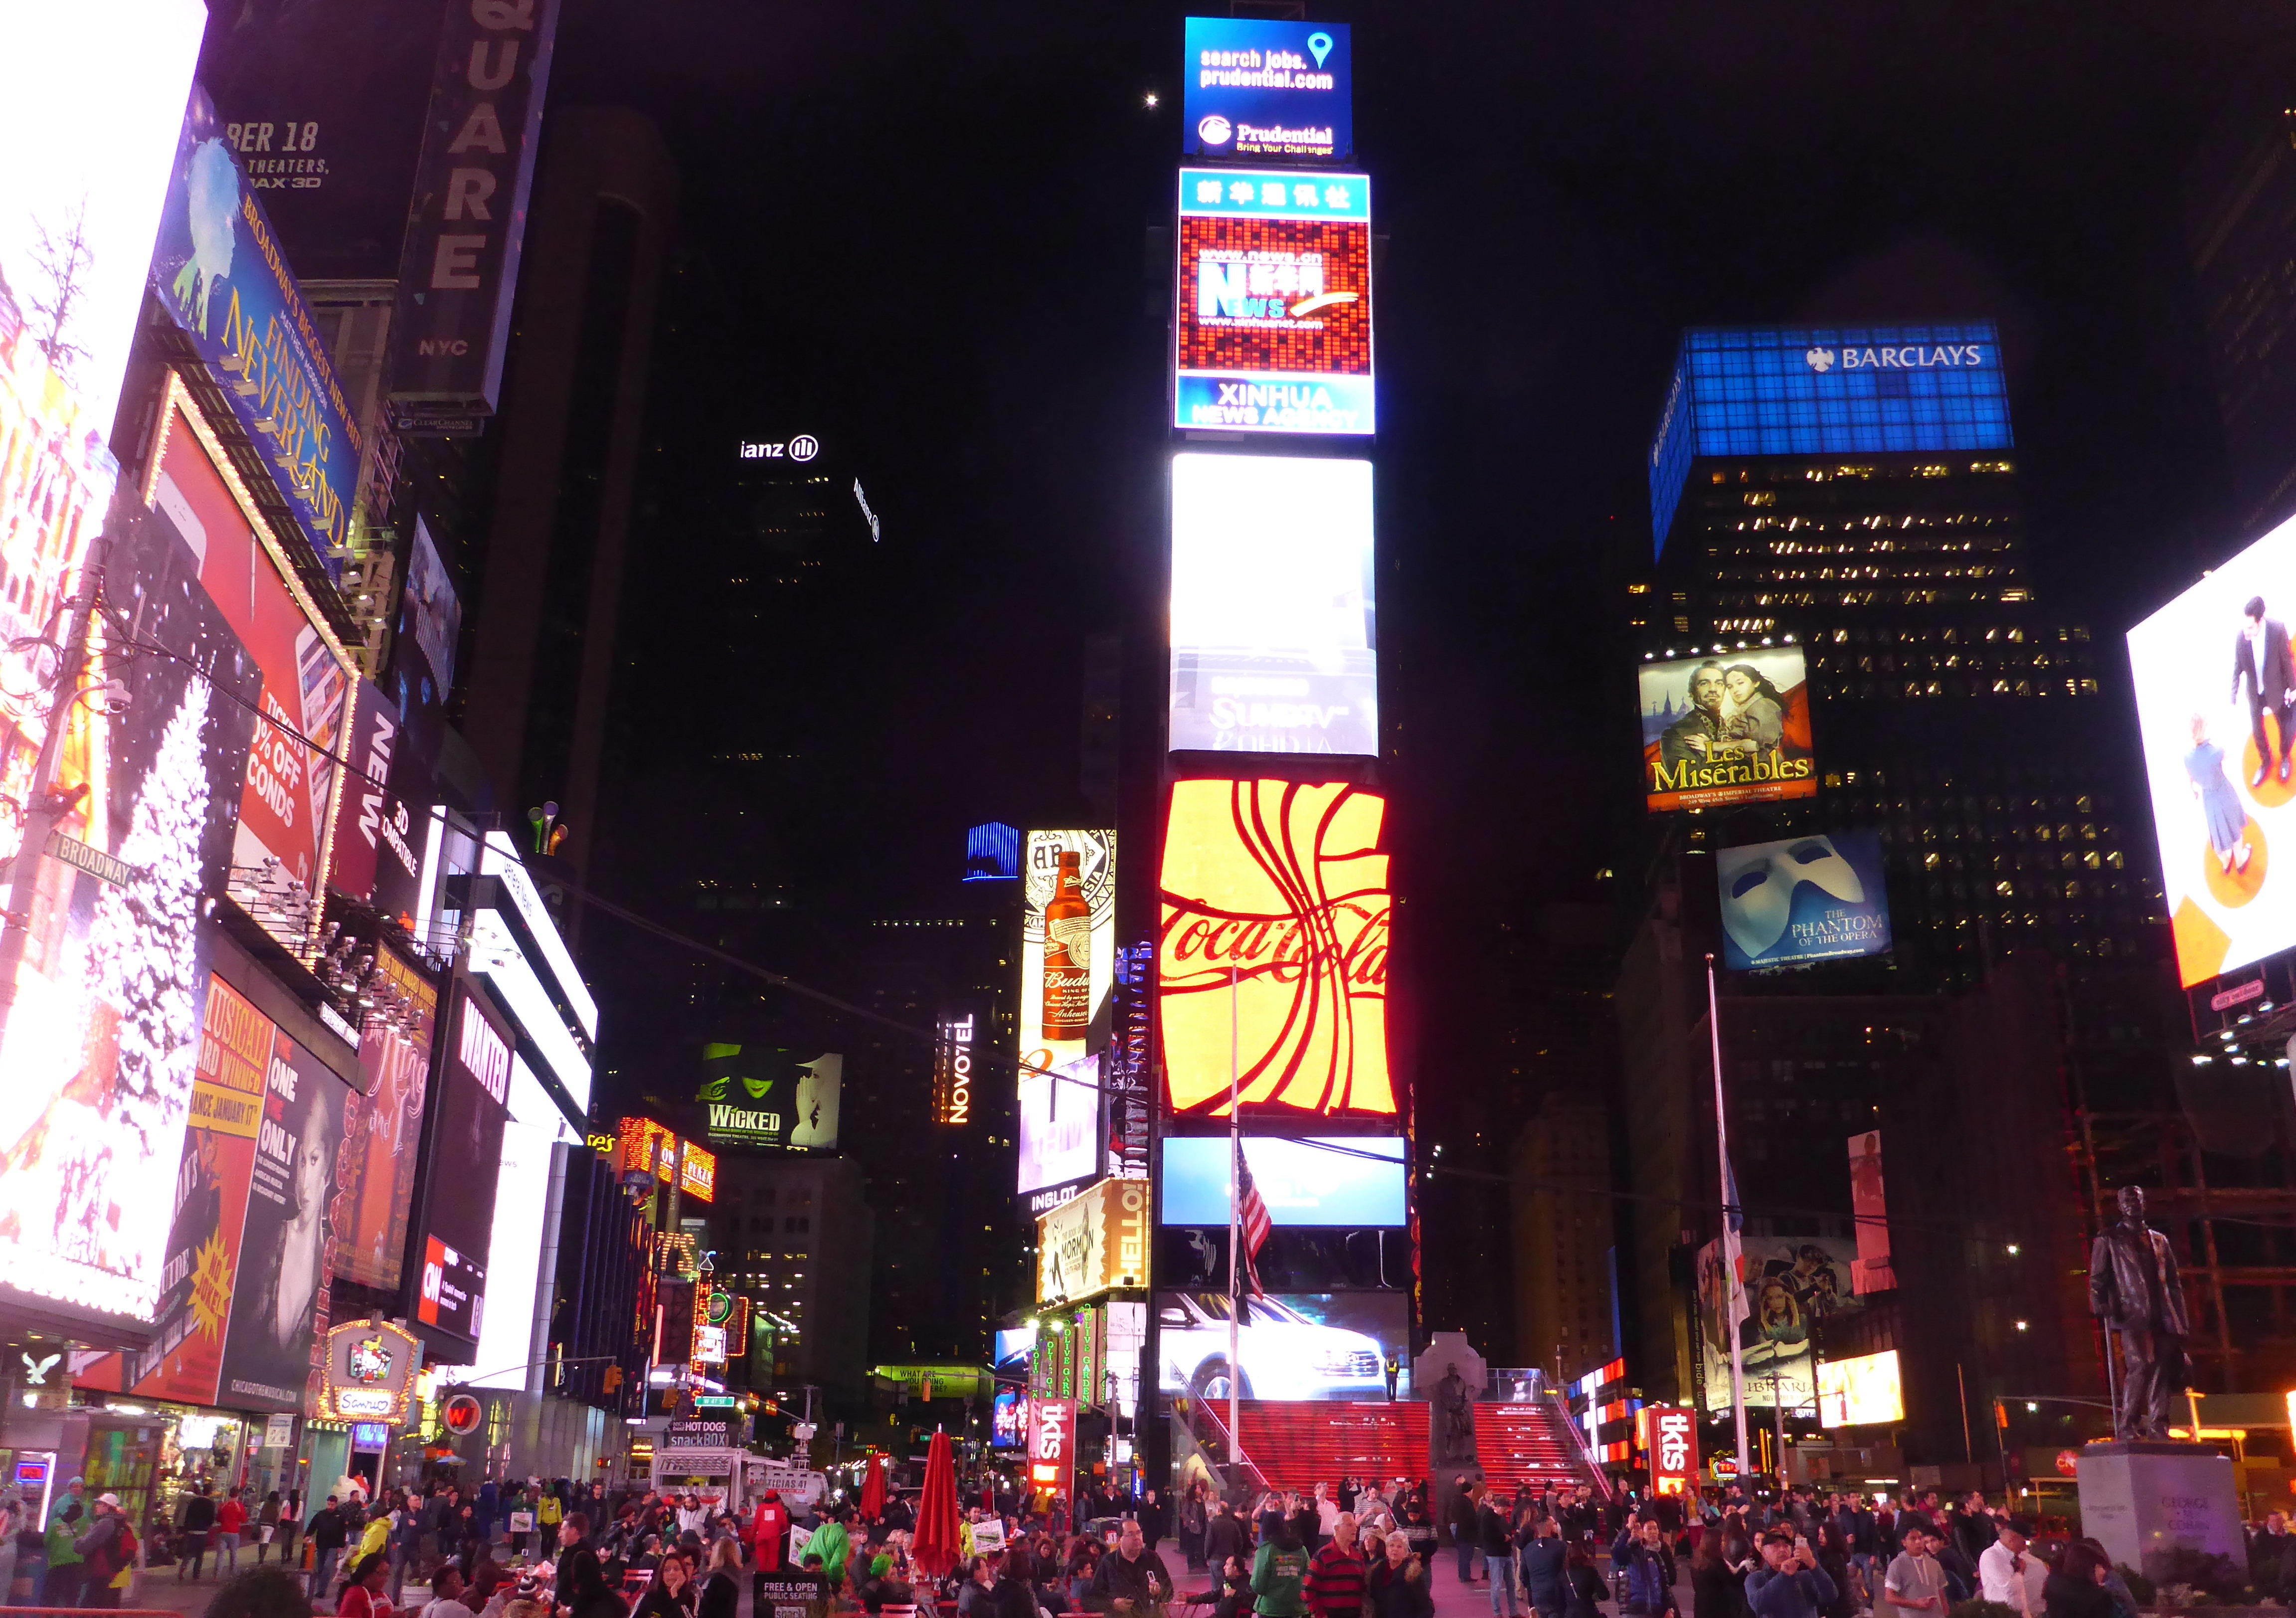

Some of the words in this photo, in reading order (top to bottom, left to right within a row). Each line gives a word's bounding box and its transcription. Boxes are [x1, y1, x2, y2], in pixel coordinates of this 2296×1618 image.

[1201, 50, 1260, 68] search
[1265, 51, 1307, 71] jobs.
[1201, 69, 1333, 90] prudential.com
[282, 121, 319, 152] 18
[1236, 143, 1260, 153] Bring
[1262, 144, 1282, 153] Your
[1237, 124, 1333, 145] Prudential
[249, 159, 330, 175] THEATERS,
[291, 178, 322, 189] 3D
[419, 340, 468, 357] NYC
[1843, 346, 1981, 369] BARCLAYS
[1218, 383, 1333, 409] XINHUA
[1192, 404, 1259, 425] NEWS
[854, 477, 873, 527] Allianz
[265, 692, 304, 759] TICKETS
[272, 741, 301, 790] OFF
[359, 711, 395, 850] NEW
[1651, 749, 1809, 792] Misérables
[1679, 792, 1717, 801] BROADWAY'S
[394, 801, 409, 836] 3D
[60, 837, 132, 885] BROADWAY
[1791, 914, 1883, 938] PHANTOM
[1825, 908, 1847, 919] THE
[1798, 937, 1813, 947] OF
[1817, 934, 1838, 944] THE
[1840, 930, 1878, 942] OPERA
[460, 996, 510, 1105] WANTED
[220, 1049, 261, 1094] WINNER
[271, 1057, 299, 1102] ONE
[948, 1013, 973, 1124] NOVOTEL
[213, 1092, 246, 1126] JANUARY
[260, 1118, 297, 1166] ONLY
[1032, 1185, 1078, 1211] INGLOT
[1061, 1228, 1094, 1262] MORMON
[1120, 1183, 1143, 1282] HELLO!
[208, 1251, 222, 1282] NO
[196, 1272, 222, 1318] JOKE!
[1084, 1313, 1092, 1352] OLIVE
[1082, 1356, 1091, 1403] GARDEN
[671, 1433, 726, 1446] snackBOX
[685, 1422, 702, 1432] HOT
[703, 1422, 726, 1432] DOGS
[1041, 1404, 1067, 1459] tkts
[1660, 1413, 1689, 1471] tkts
[797, 1480, 807, 1489] 41
[764, 1582, 785, 1592] FREE
[786, 1582, 793, 1592] &
[795, 1582, 818, 1592] OPEN
